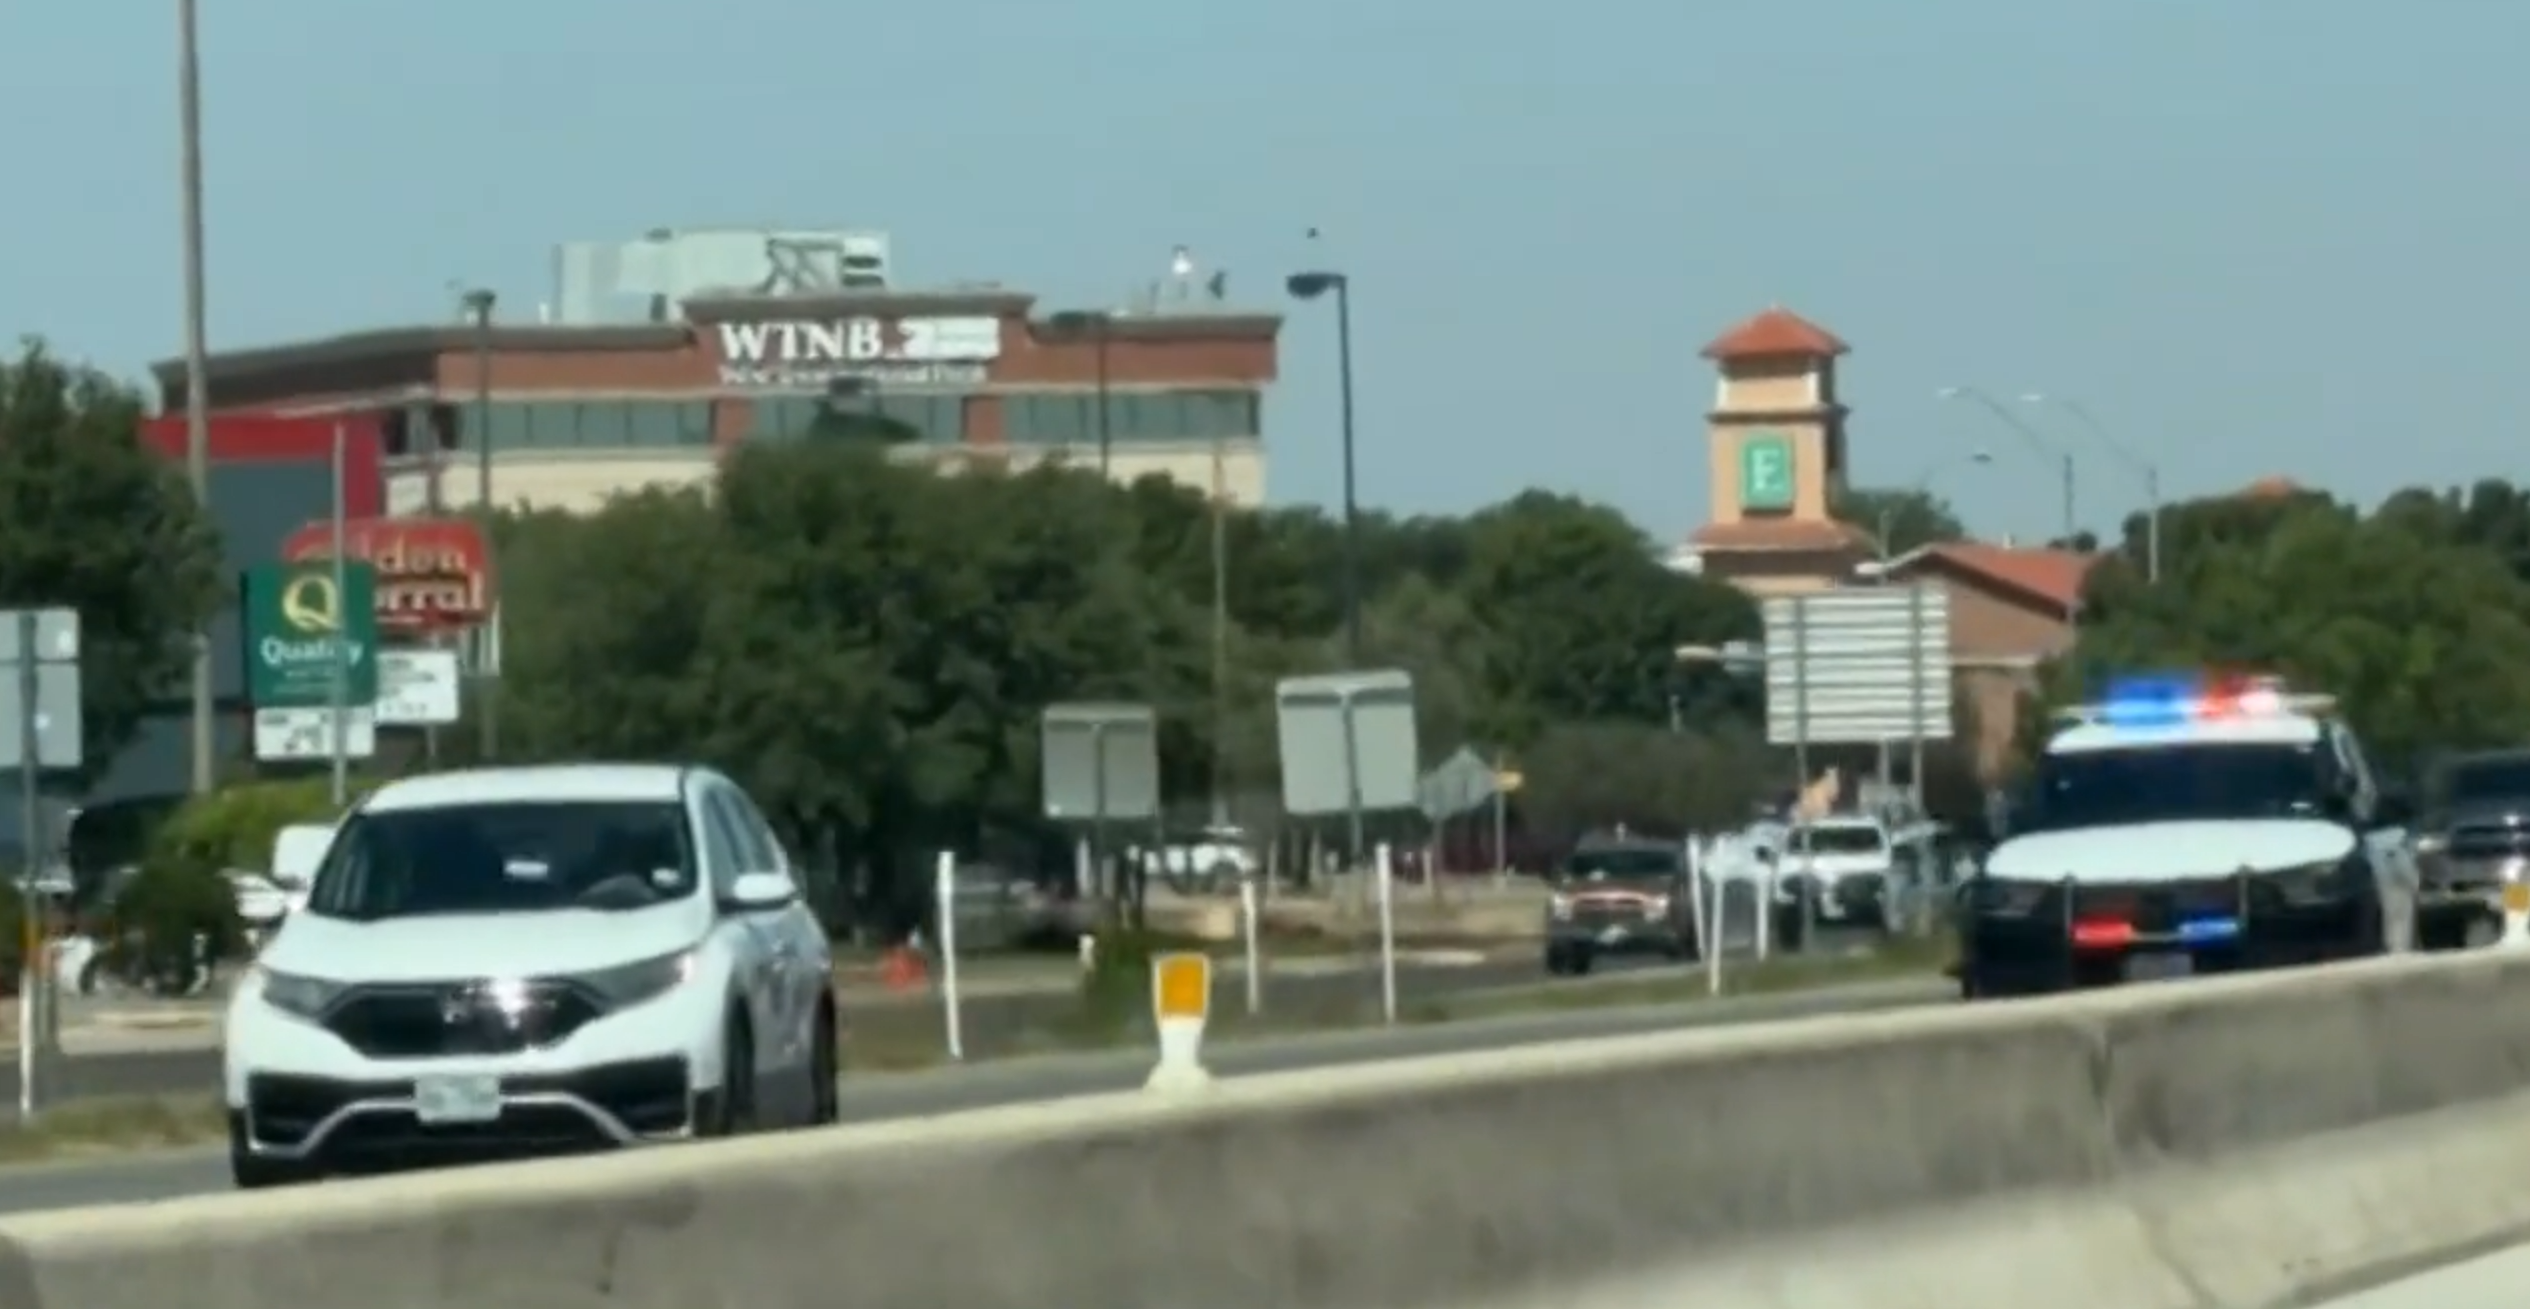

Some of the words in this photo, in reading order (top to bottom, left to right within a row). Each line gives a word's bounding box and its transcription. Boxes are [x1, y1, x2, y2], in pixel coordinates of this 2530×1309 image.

[717, 321, 883, 361] WTNB
[1752, 448, 1784, 492] E
[283, 574, 342, 631] Q
[260, 636, 363, 667] Qualiy
